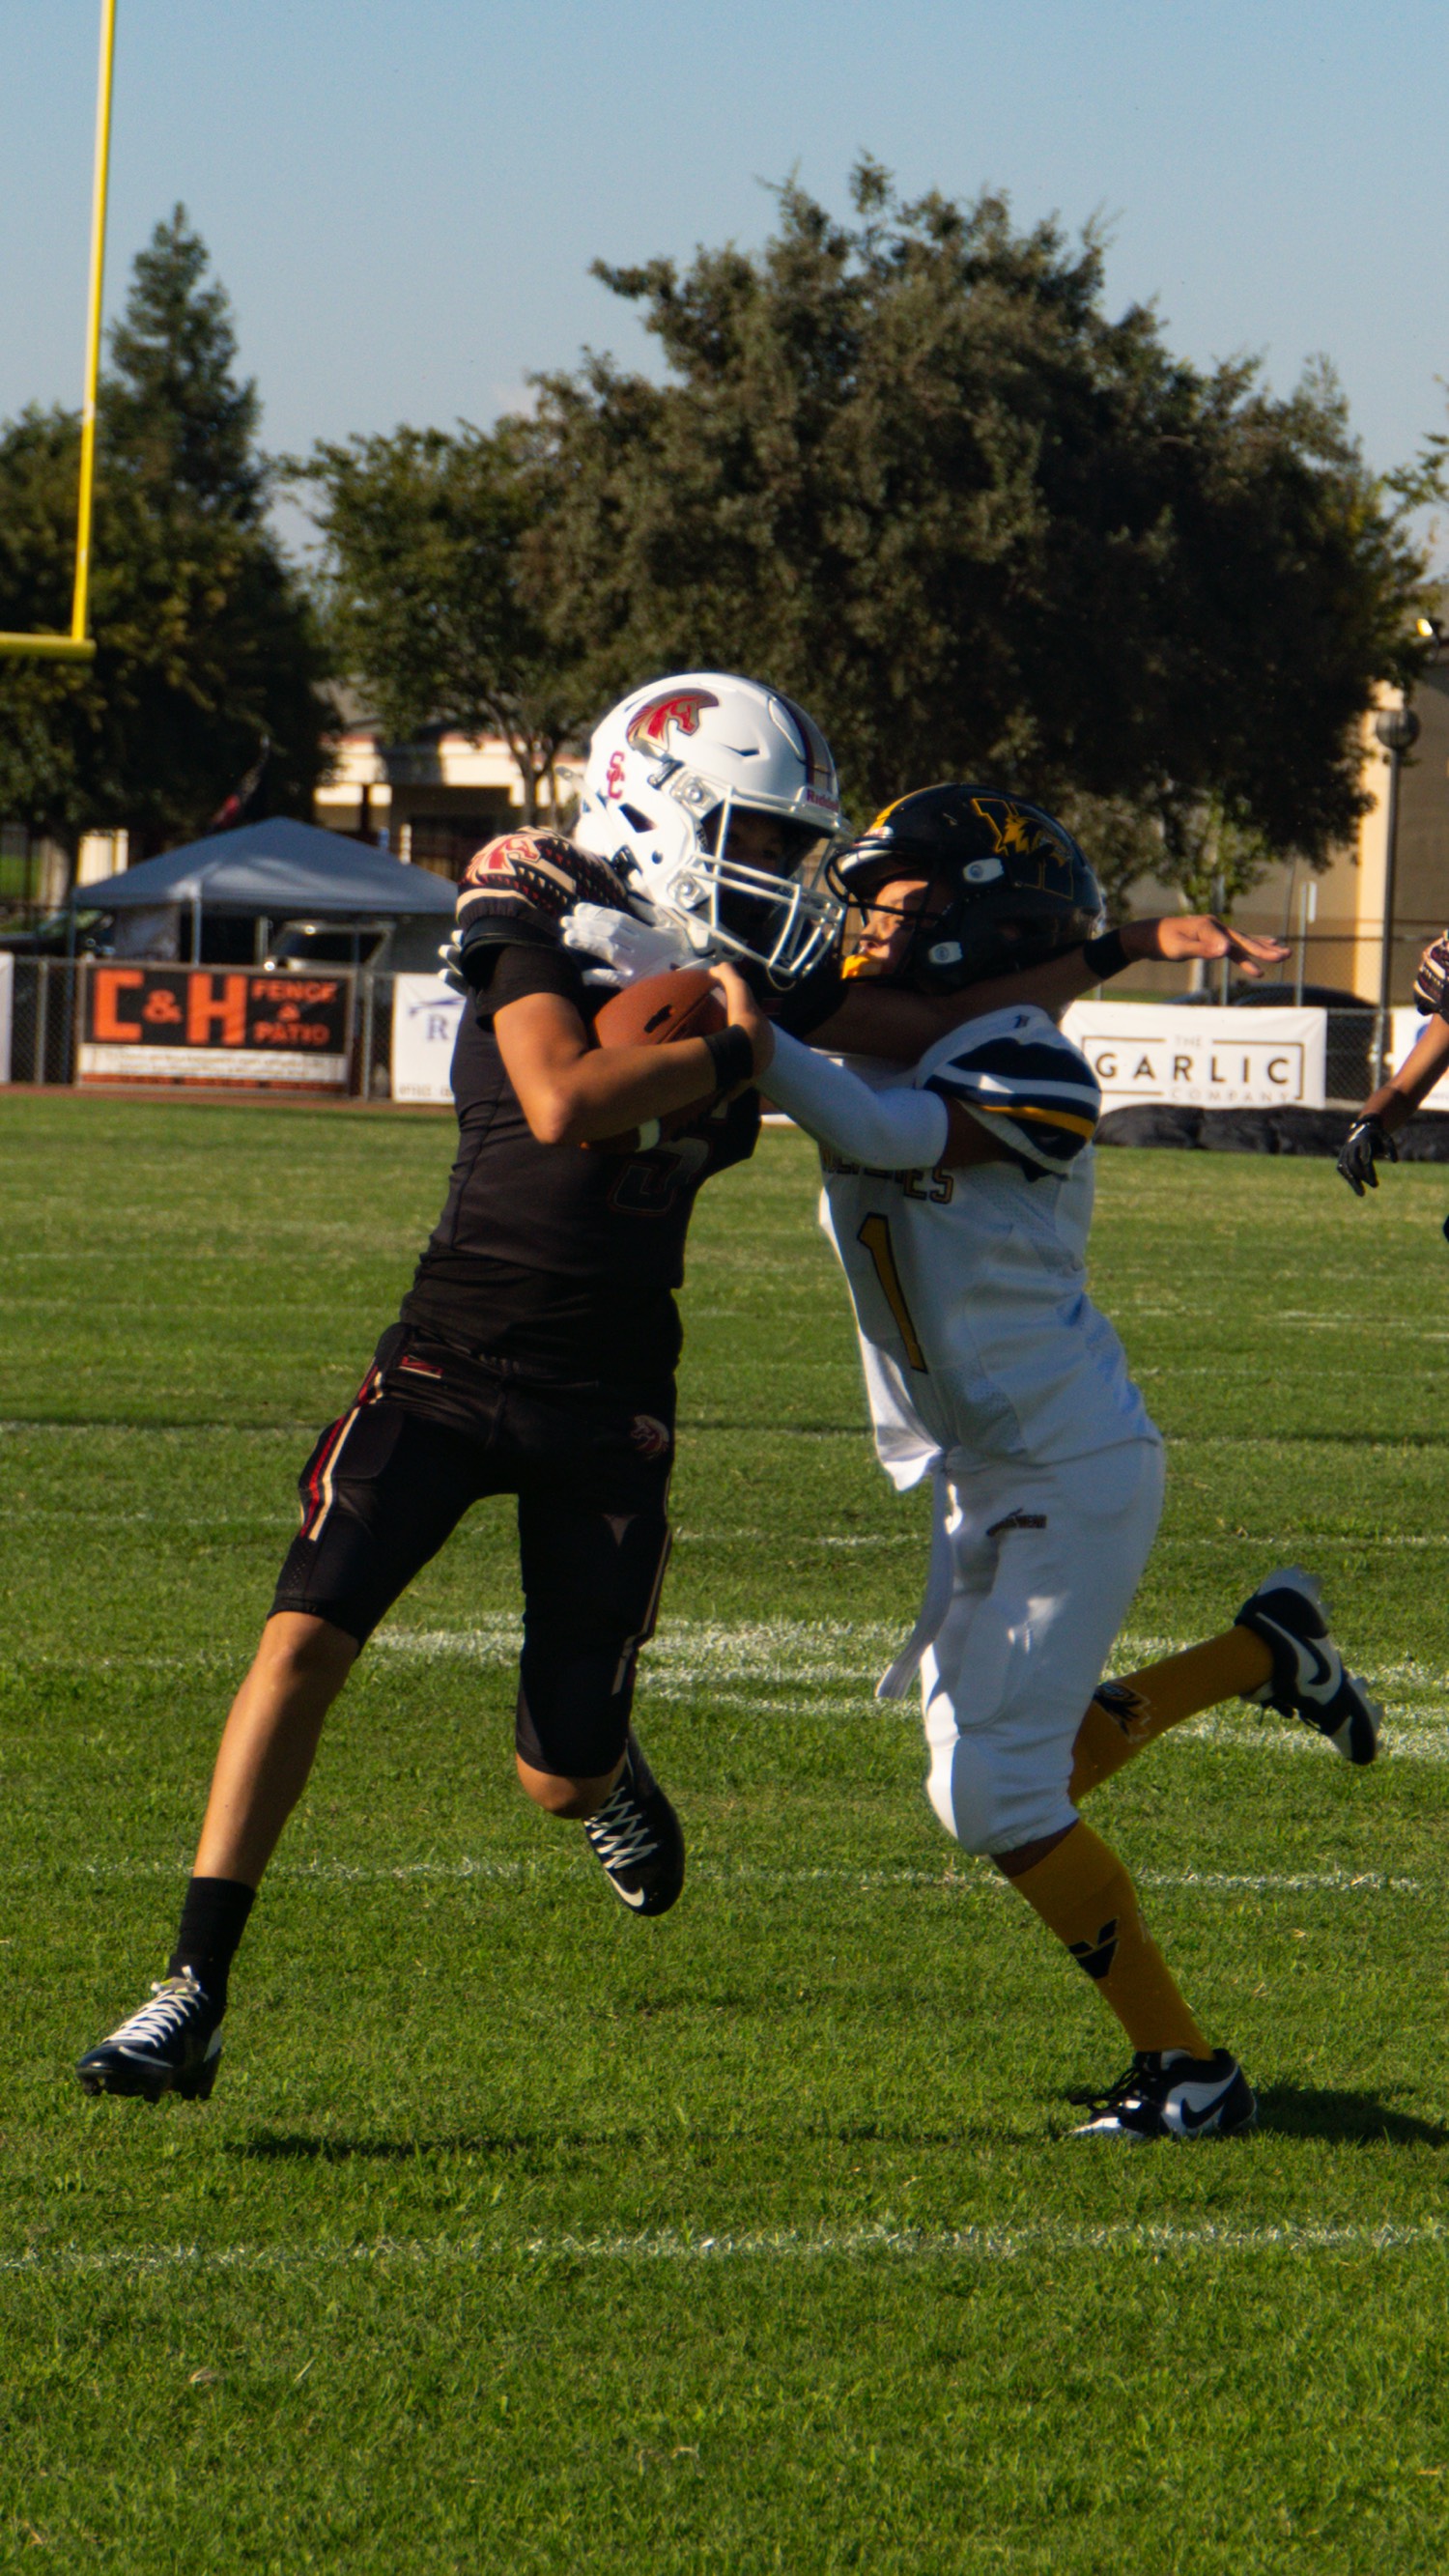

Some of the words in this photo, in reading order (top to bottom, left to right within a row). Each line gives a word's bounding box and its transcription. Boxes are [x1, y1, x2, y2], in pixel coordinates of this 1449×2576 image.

[144, 989, 182, 1022] &
[186, 972, 247, 1046] H
[1174, 1034, 1203, 1050] THE
[1094, 1052, 1291, 1085] GARLIC
[1170, 1087, 1296, 1102] COMPANY
[857, 1211, 929, 1374] 1
